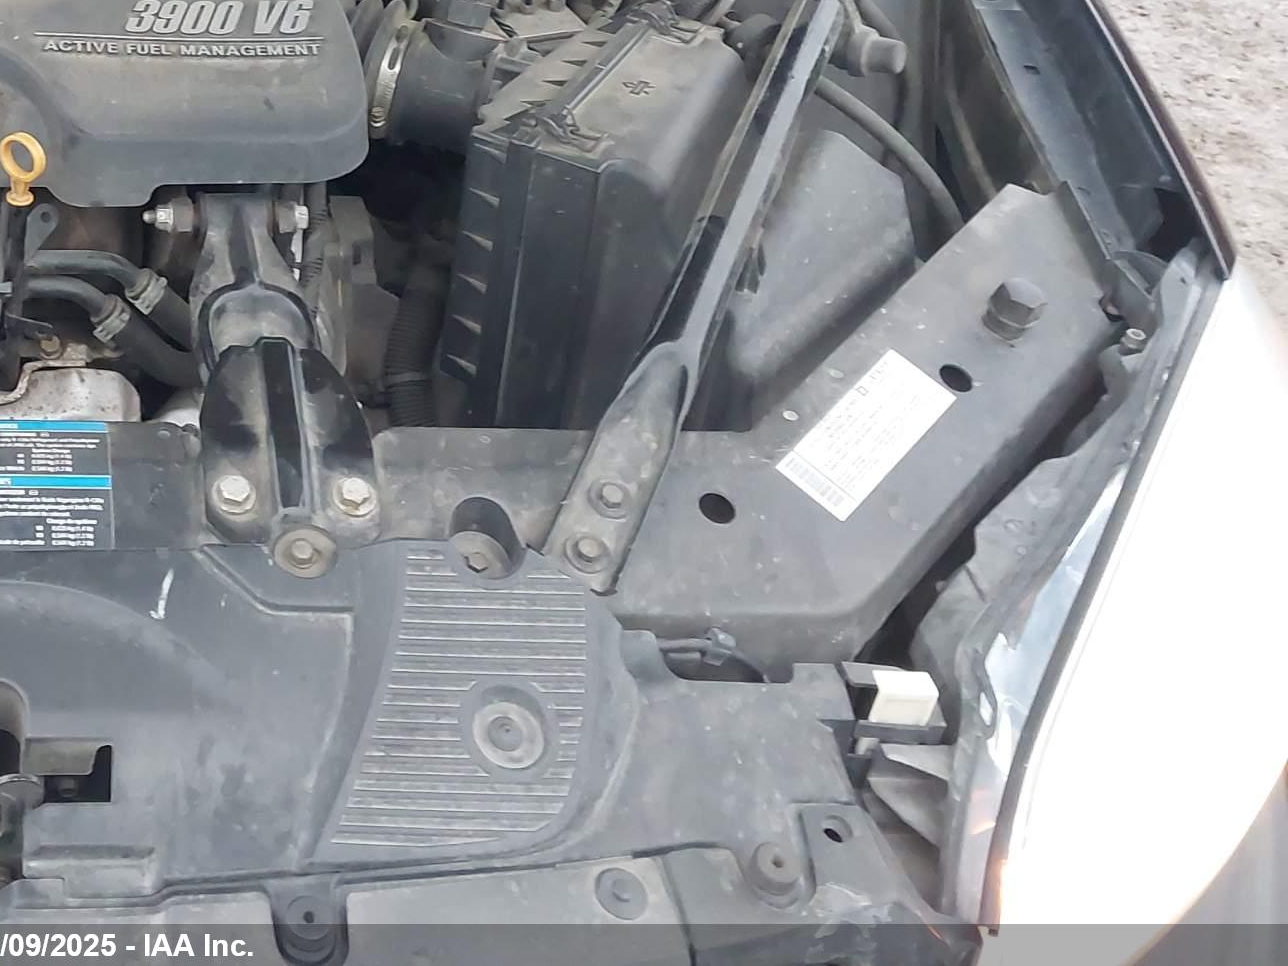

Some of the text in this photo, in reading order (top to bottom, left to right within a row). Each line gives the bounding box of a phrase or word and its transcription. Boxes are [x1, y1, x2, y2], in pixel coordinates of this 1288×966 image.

[124, 0, 244, 35] 3900
[43, 40, 322, 58] ACTIVE FUEL MANAGEMENT
